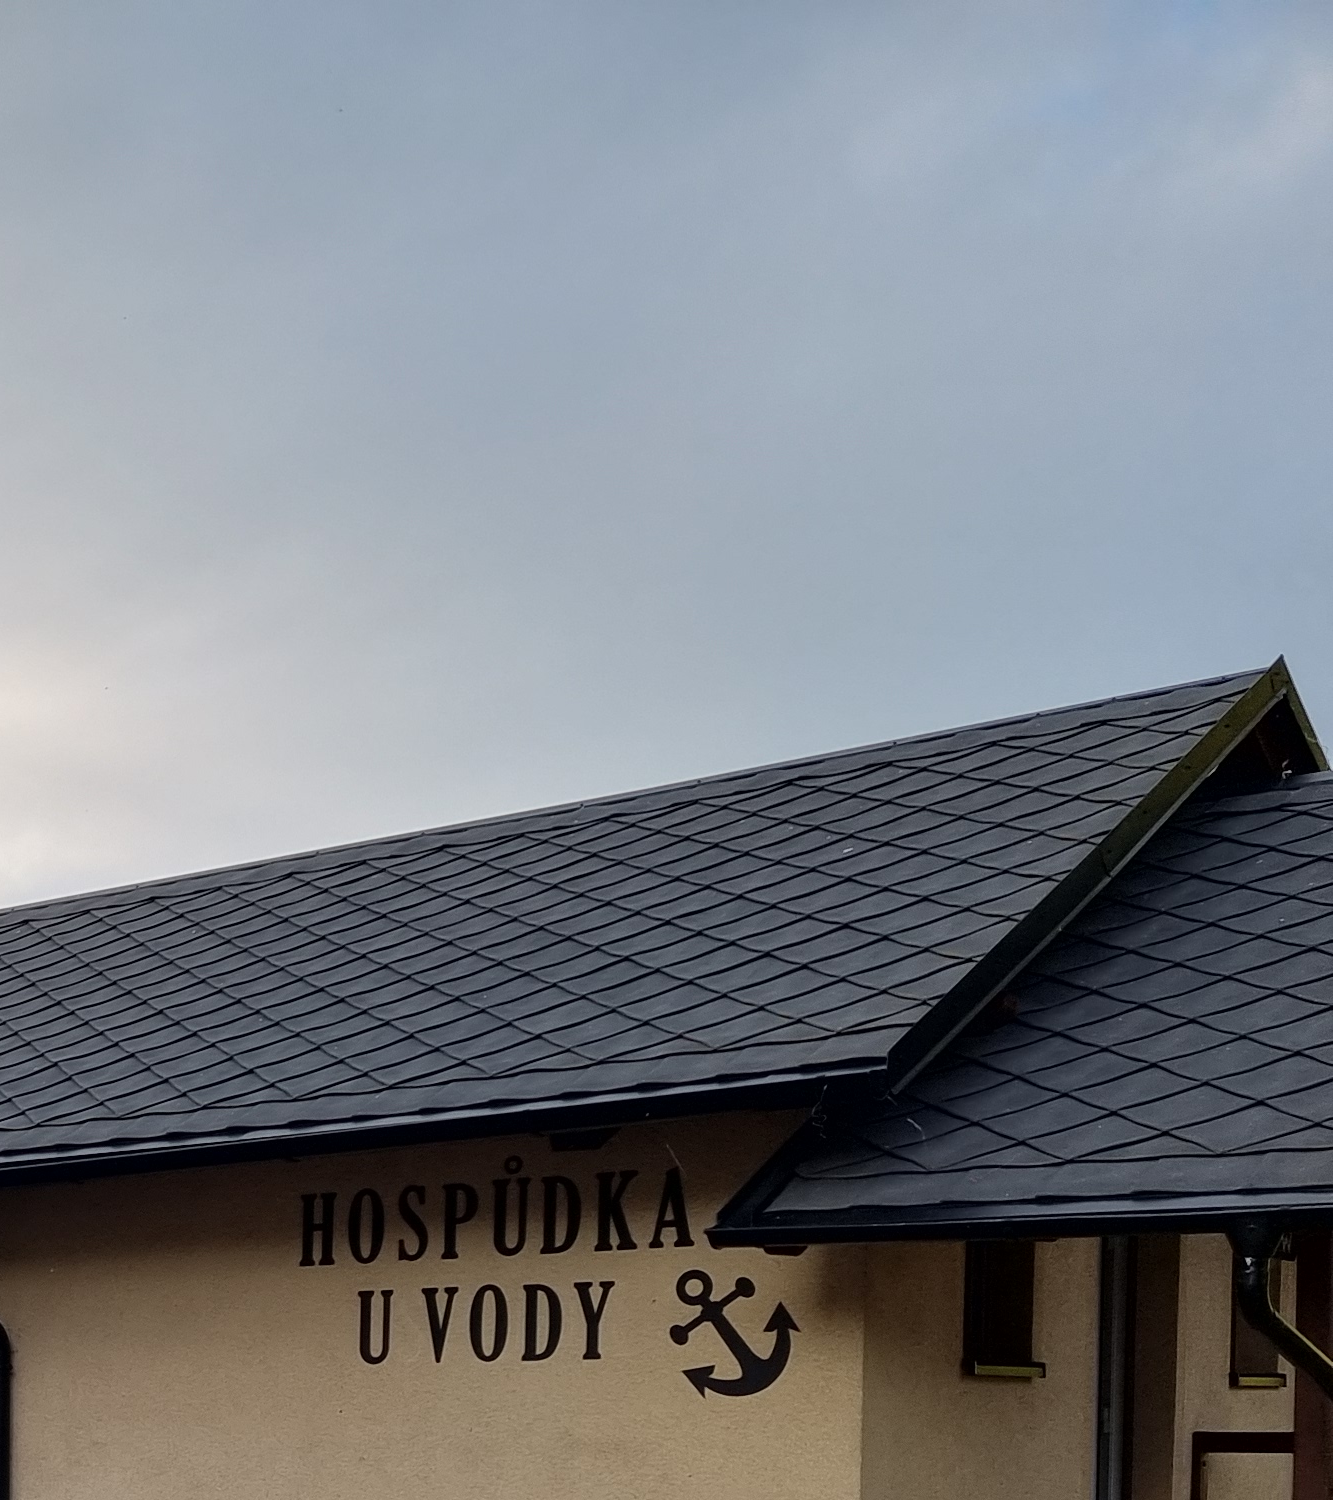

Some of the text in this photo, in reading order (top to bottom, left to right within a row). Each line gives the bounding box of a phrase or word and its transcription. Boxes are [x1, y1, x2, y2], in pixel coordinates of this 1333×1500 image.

[299, 1156, 694, 1266] HOSPŮDKA
[357, 1281, 615, 1365] U VODY
